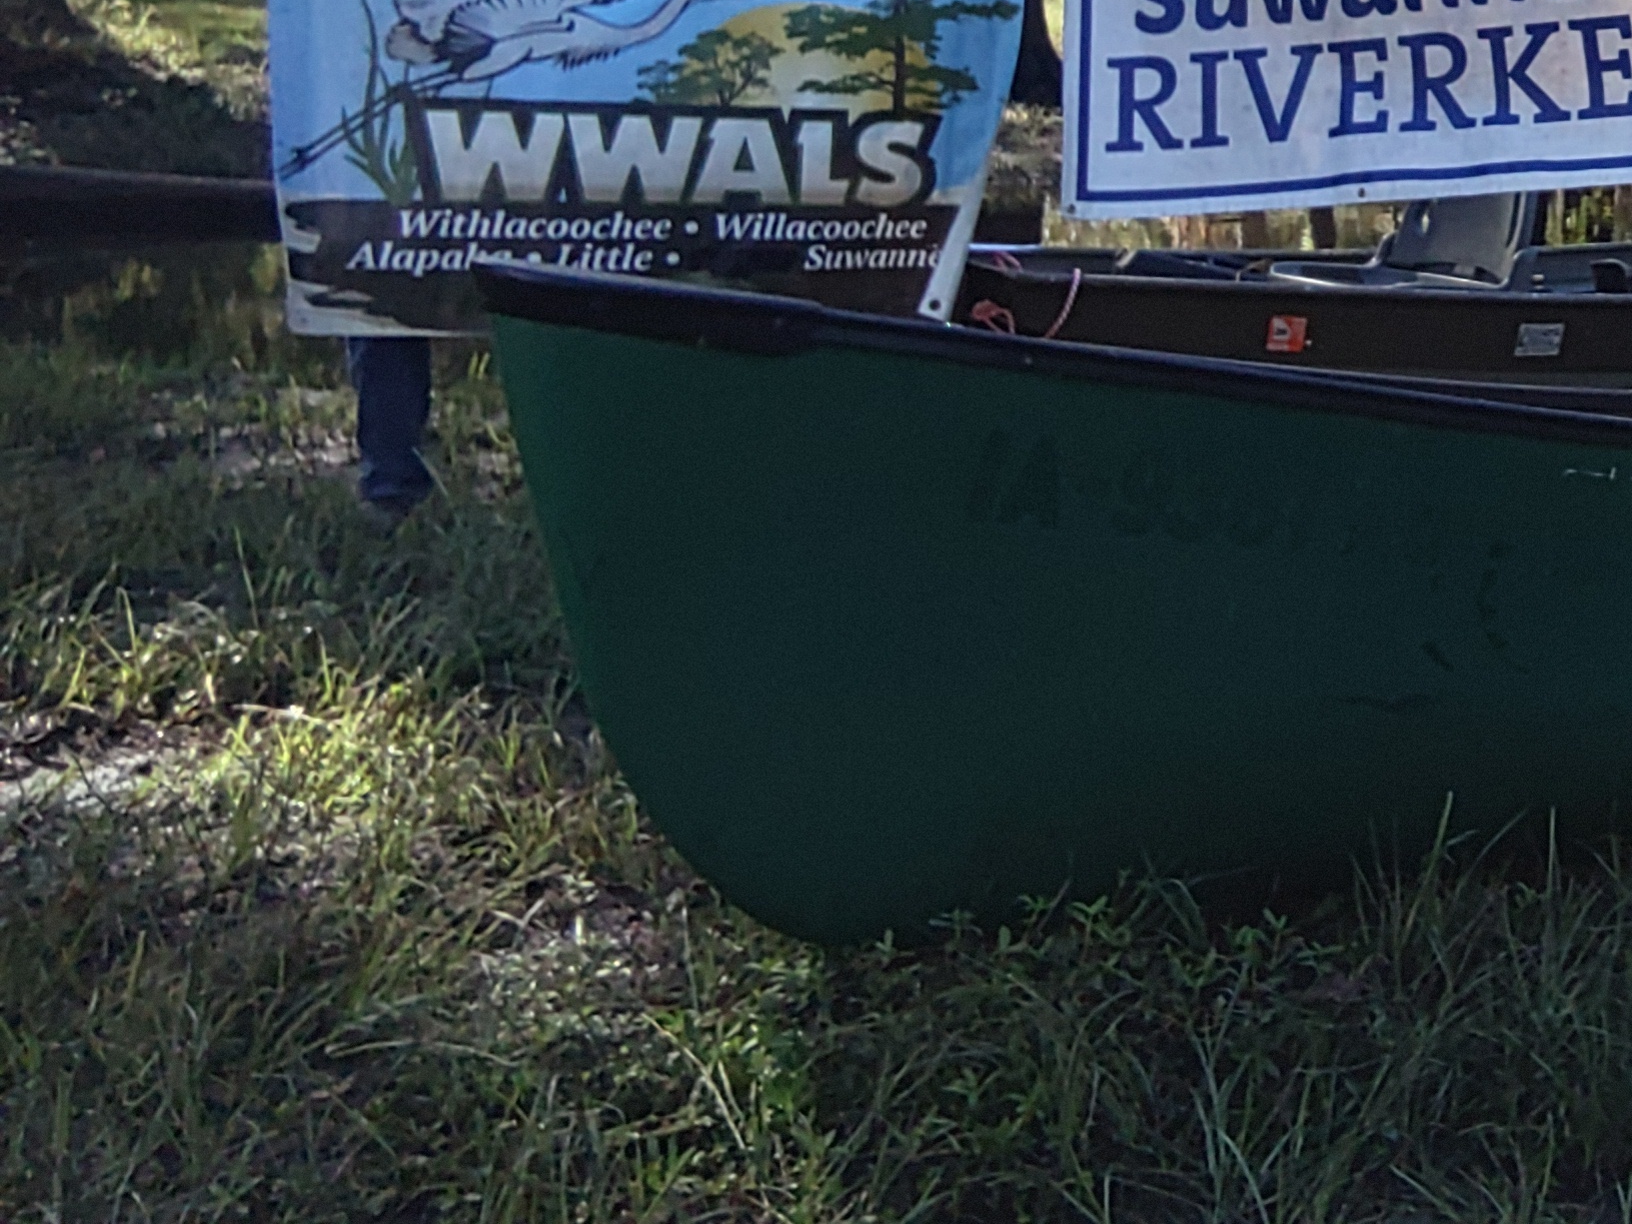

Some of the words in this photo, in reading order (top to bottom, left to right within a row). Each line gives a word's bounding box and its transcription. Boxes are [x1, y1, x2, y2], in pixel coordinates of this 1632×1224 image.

[426, 109, 924, 207] WWALS
[400, 209, 672, 240] Withlacoochee
[715, 212, 928, 240] Willacoochee
[558, 242, 654, 272] Little
[803, 243, 940, 271] Suwanne
